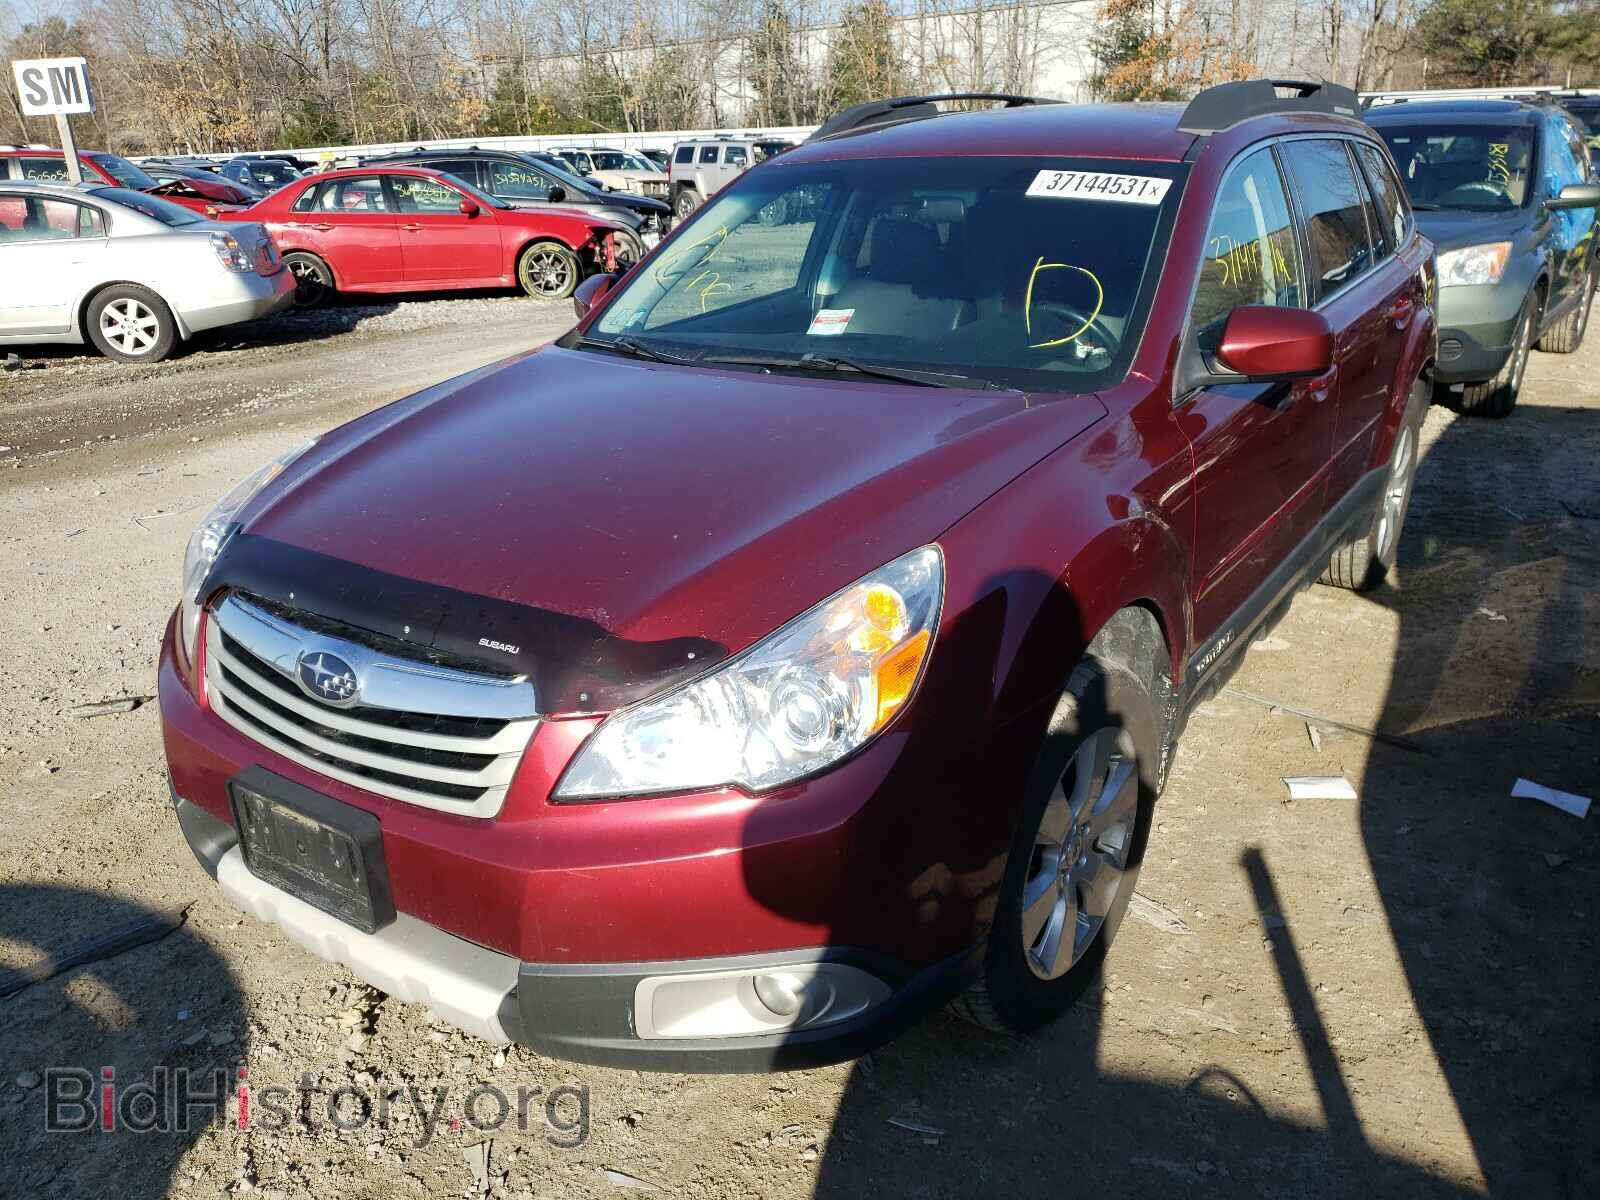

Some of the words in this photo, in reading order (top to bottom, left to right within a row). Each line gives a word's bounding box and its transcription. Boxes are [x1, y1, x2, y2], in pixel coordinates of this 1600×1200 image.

[22, 66, 83, 106] SM
[1046, 172, 1150, 197] 37144531
[1025, 256, 1104, 348] D
[478, 637, 520, 654] SUBARU
